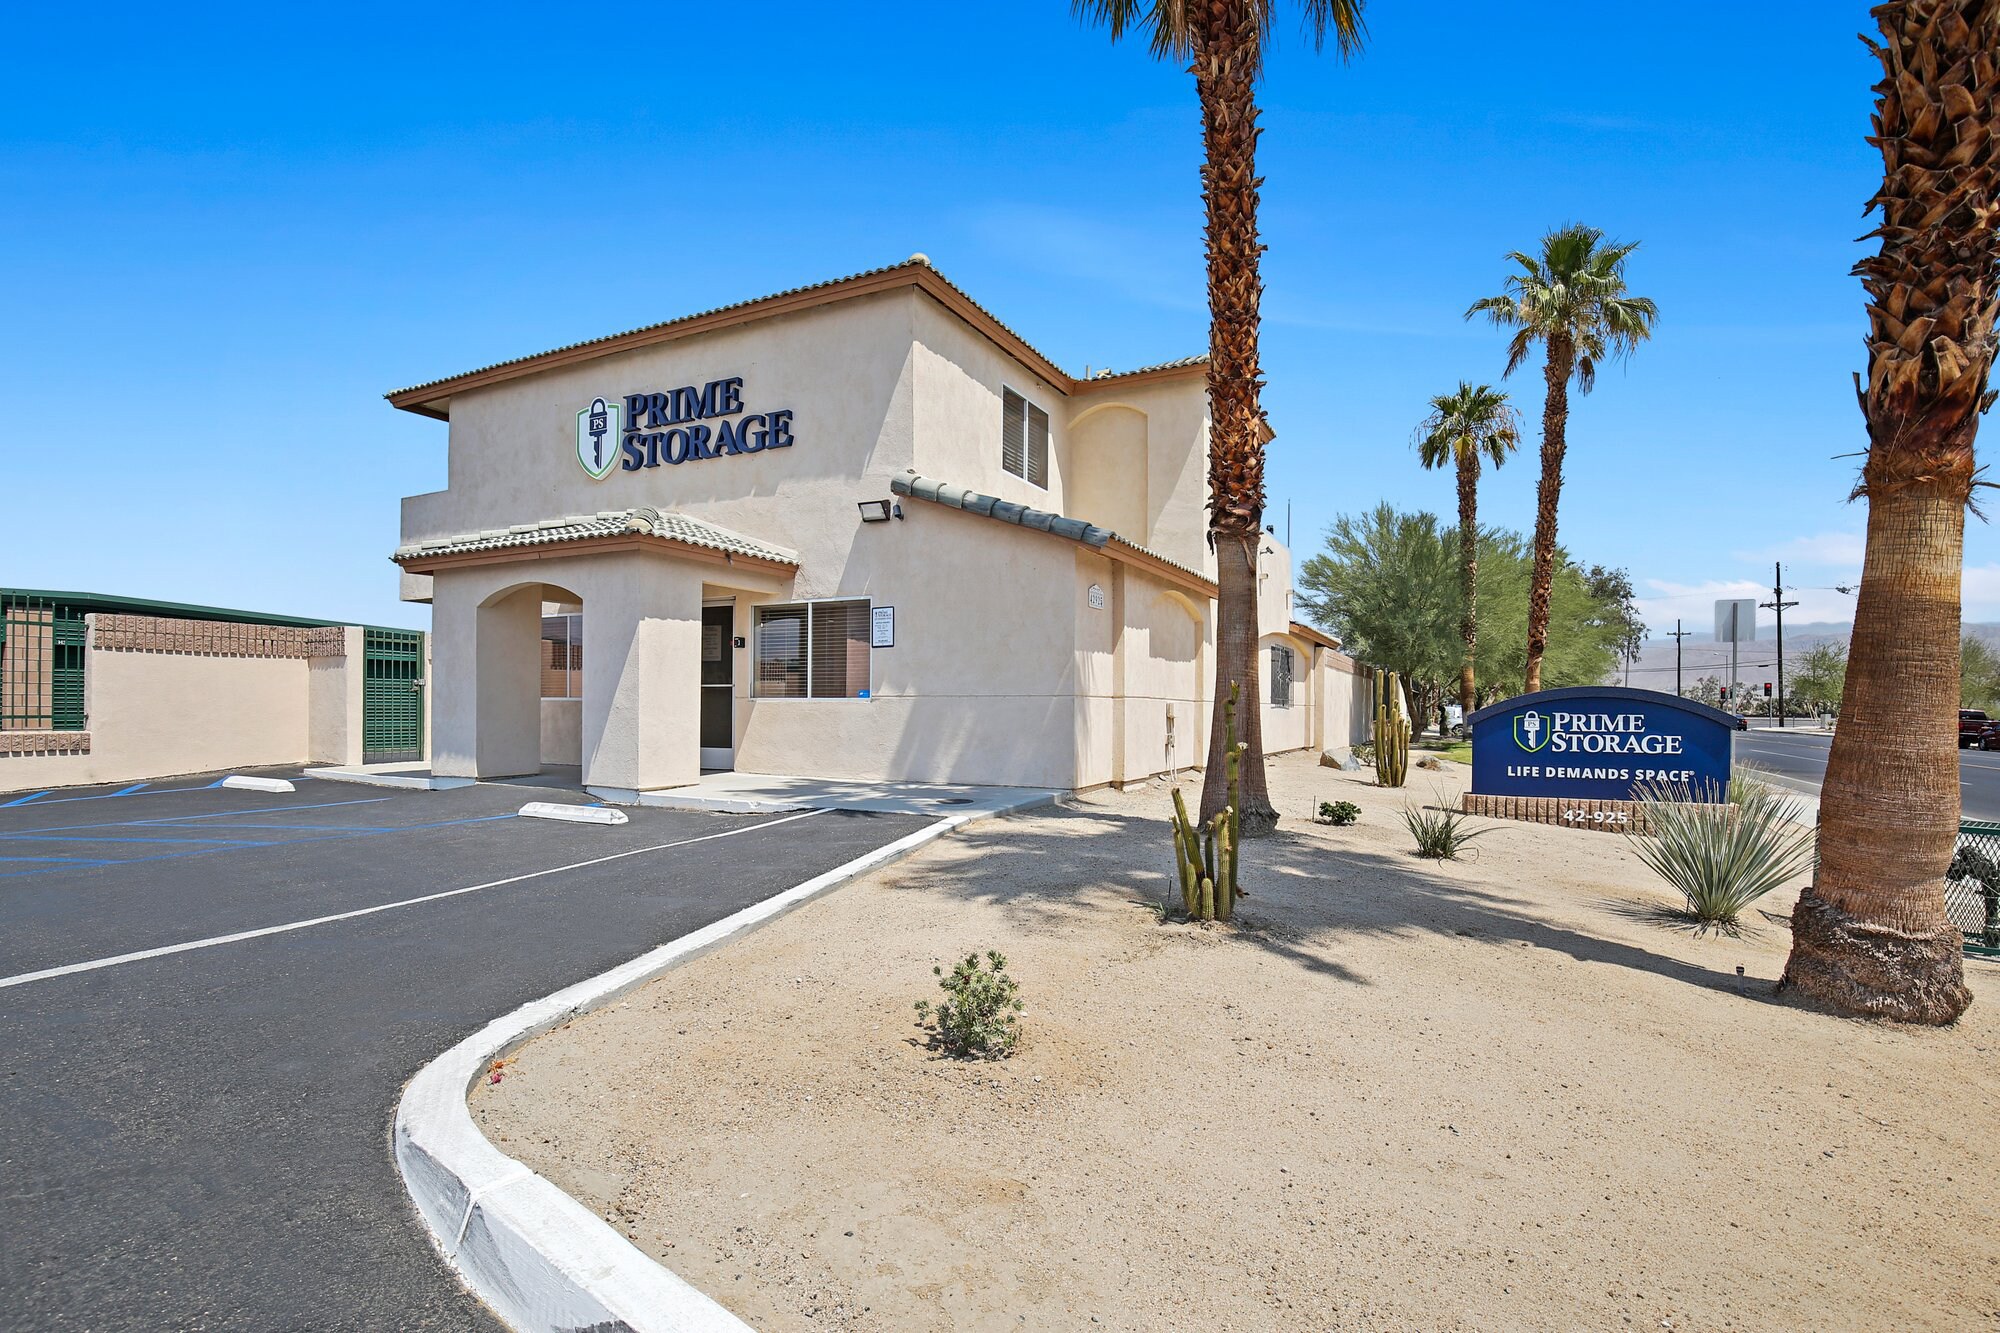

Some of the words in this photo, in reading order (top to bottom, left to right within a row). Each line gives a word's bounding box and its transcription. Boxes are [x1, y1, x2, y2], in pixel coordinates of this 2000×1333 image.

[623, 377, 744, 432] PRIME
[592, 418, 604, 429] PS
[622, 409, 794, 471] STORAGE
[1552, 712, 1645, 733] PRIME
[1551, 732, 1683, 755] STORAGE
[1507, 766, 1540, 777] LIFE
[1545, 767, 1629, 780] DEMANDS
[1563, 809, 1628, 824] 42-925
